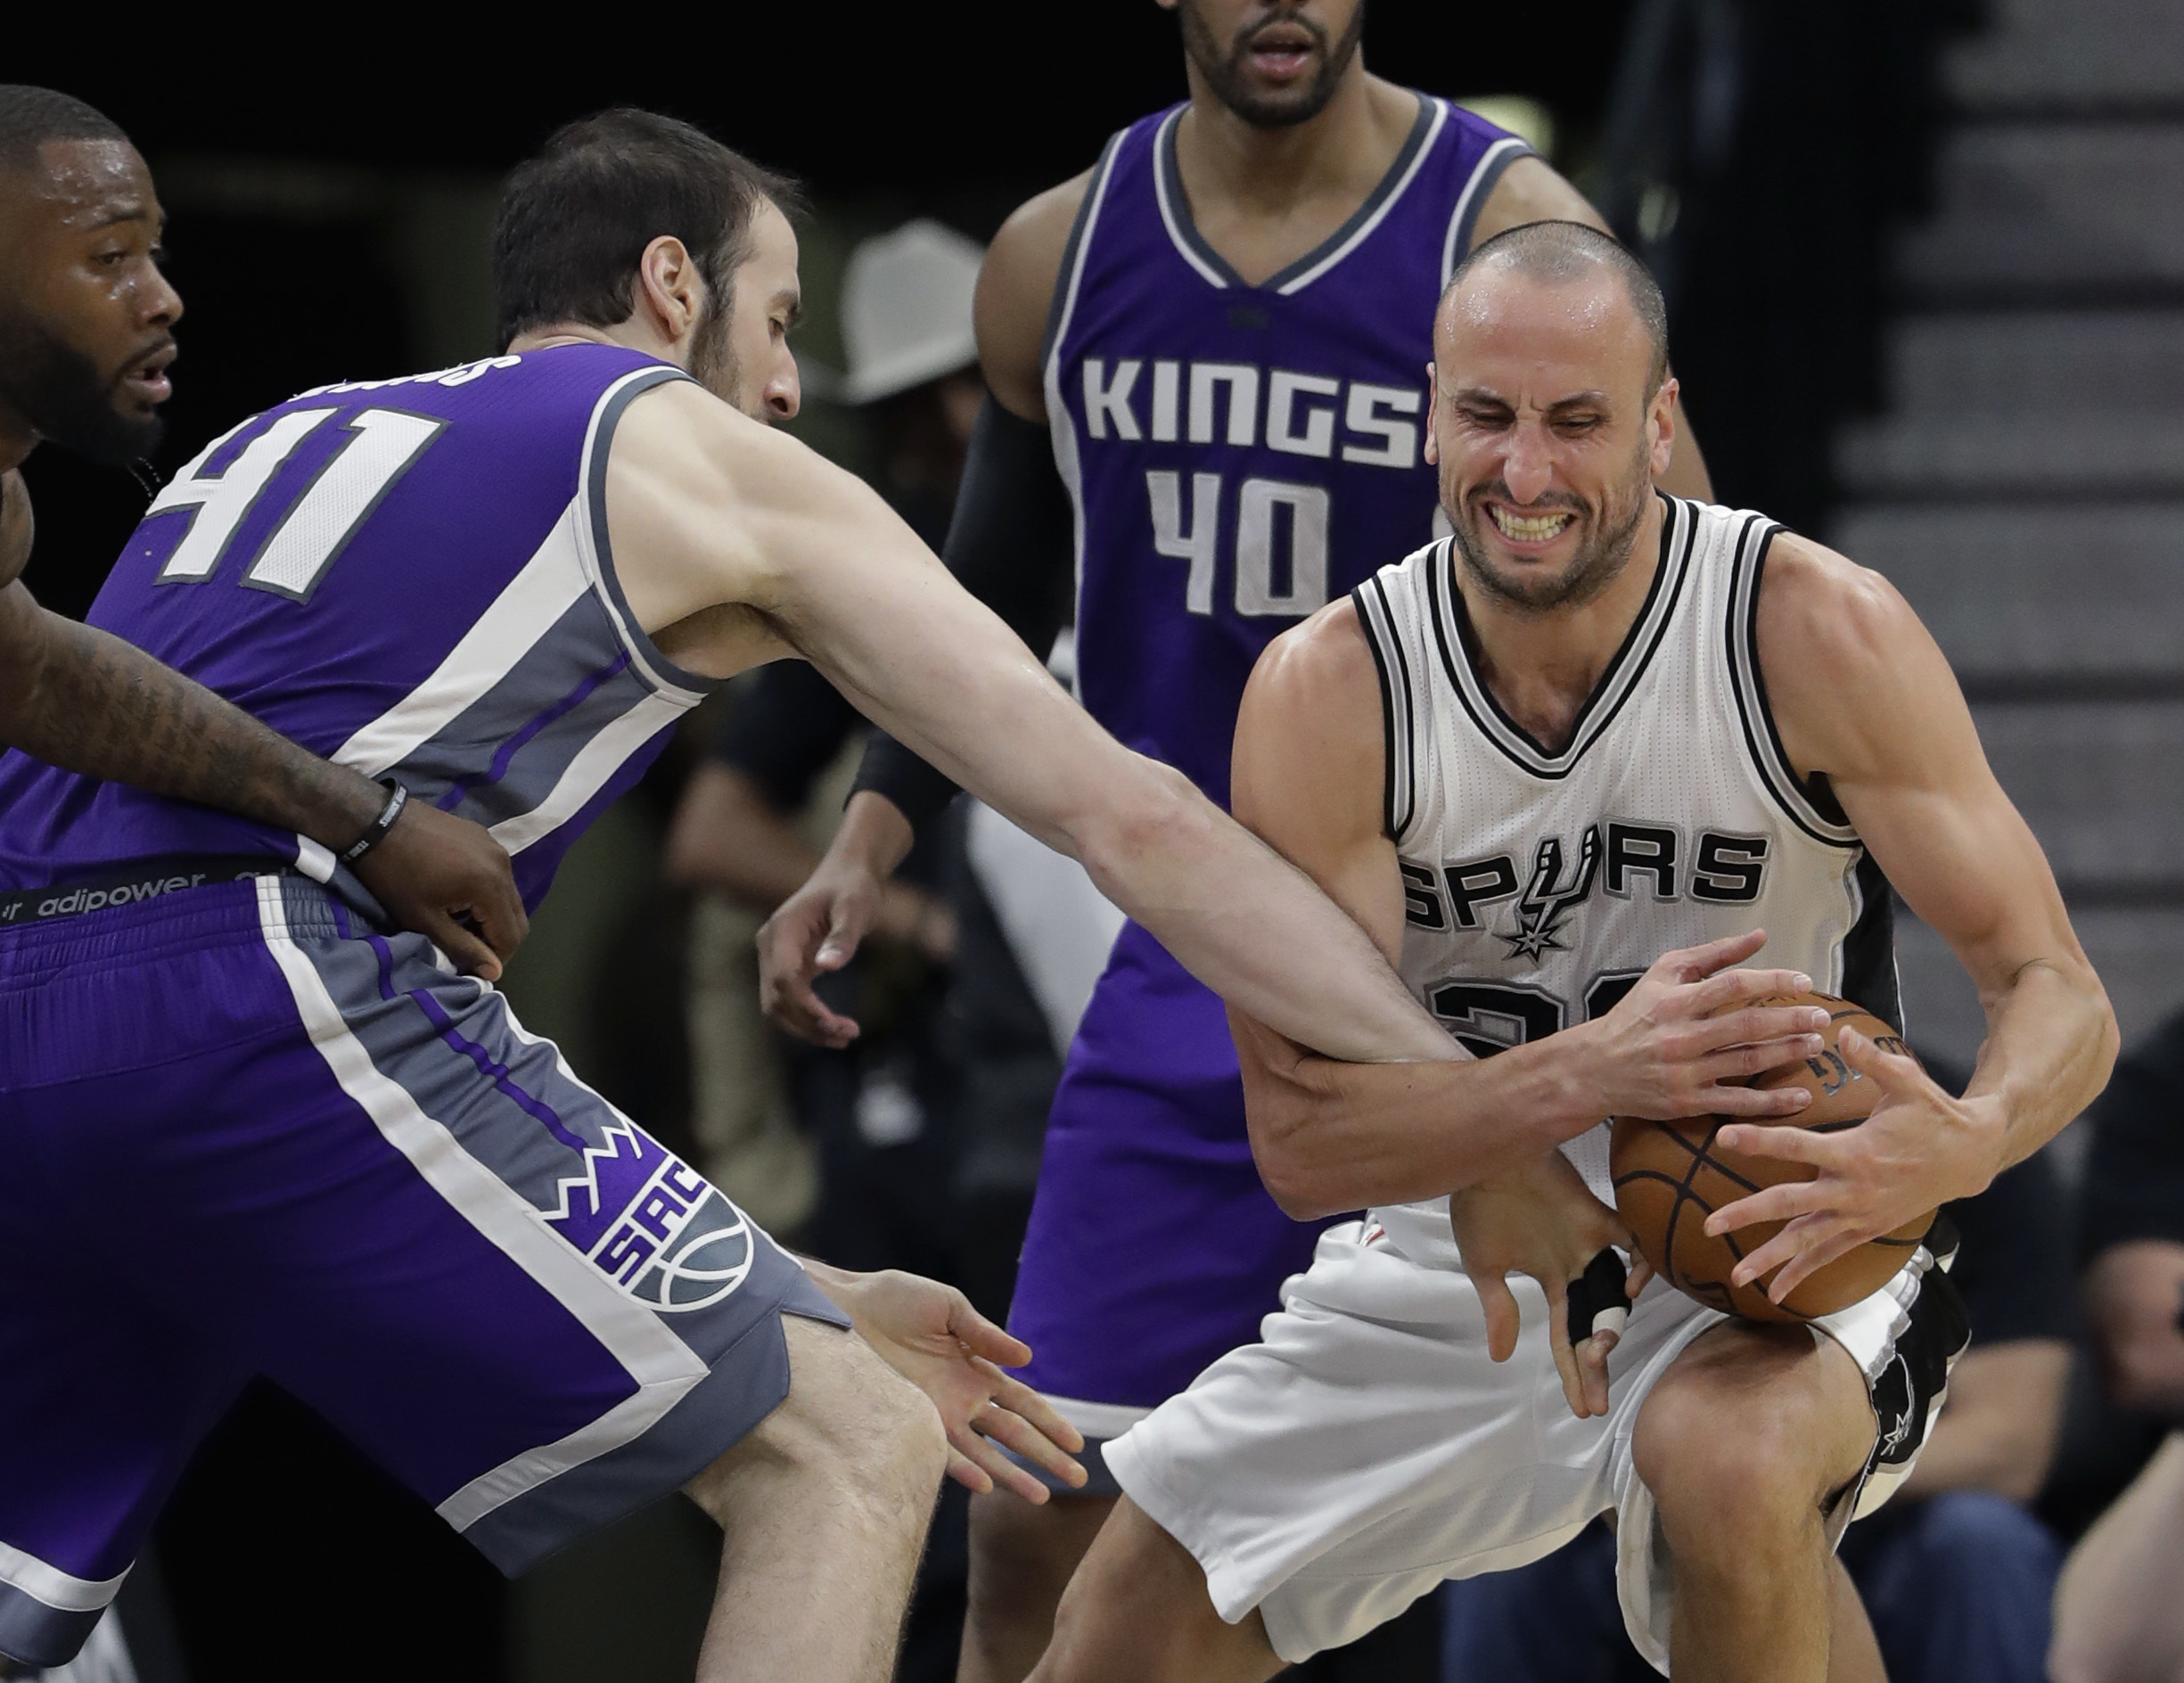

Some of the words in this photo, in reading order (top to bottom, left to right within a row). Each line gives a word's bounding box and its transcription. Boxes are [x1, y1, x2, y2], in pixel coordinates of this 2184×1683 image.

[1082, 358, 1421, 469] KINGS
[144, 406, 451, 604] 41
[1145, 470, 1330, 616] 40
[37, 870, 206, 918] adipower
[593, 1160, 708, 1287] SAC
